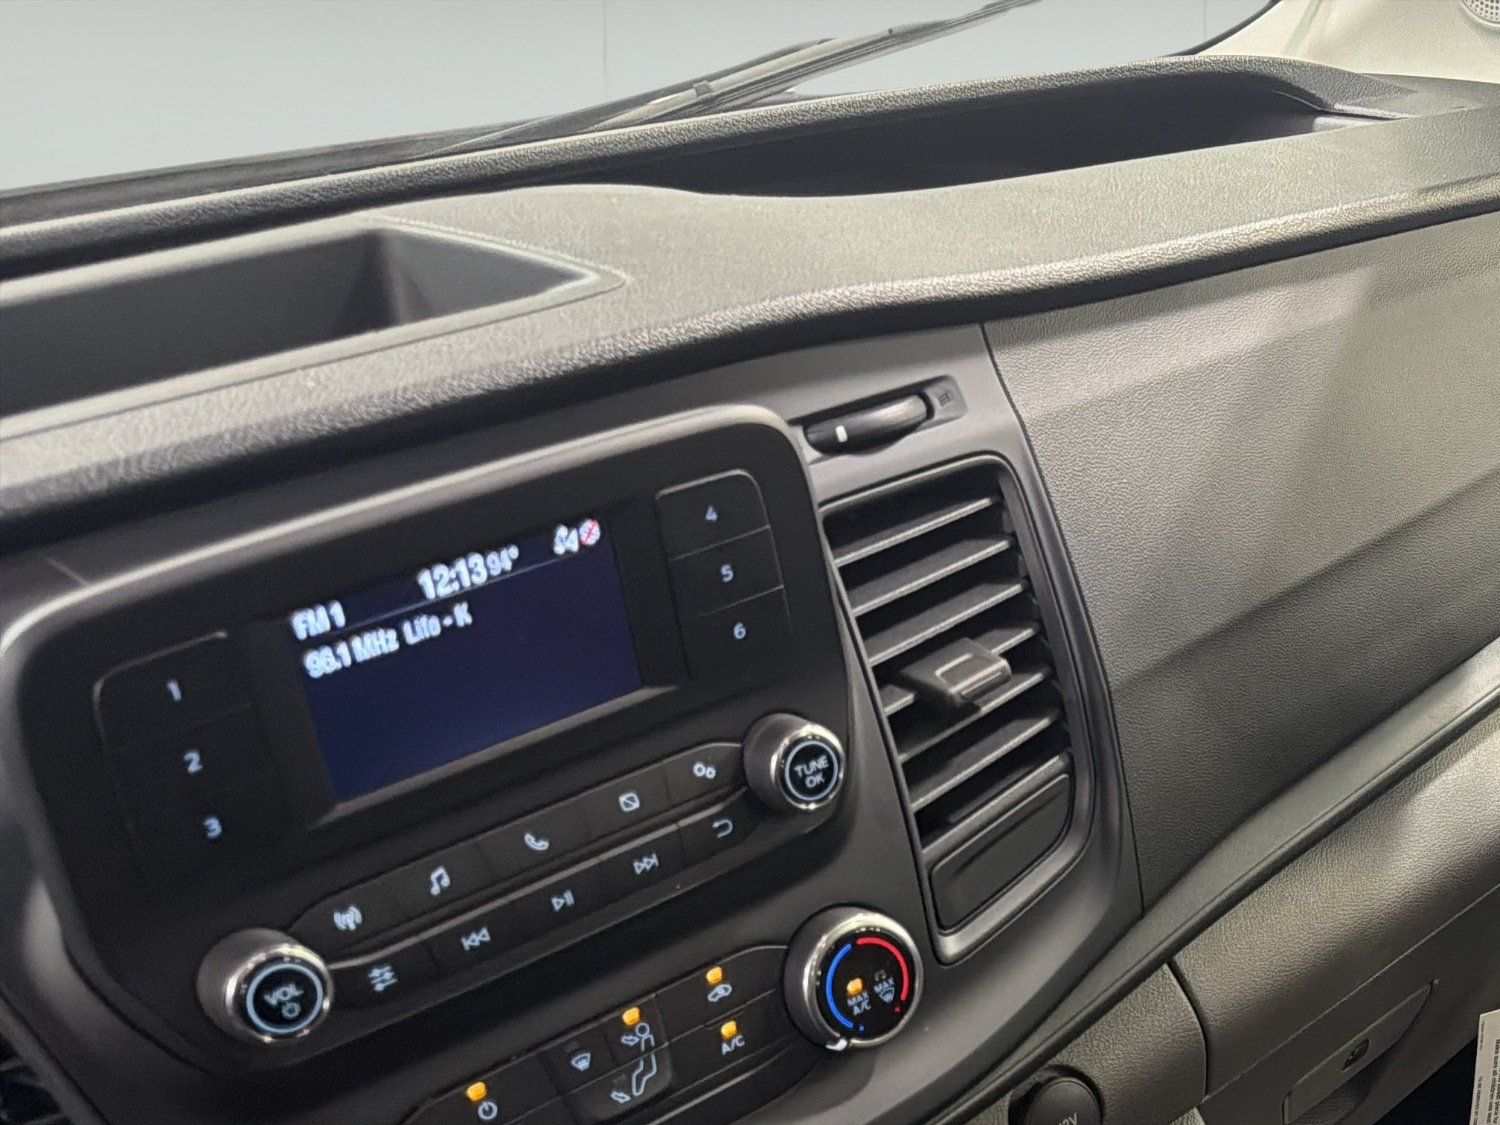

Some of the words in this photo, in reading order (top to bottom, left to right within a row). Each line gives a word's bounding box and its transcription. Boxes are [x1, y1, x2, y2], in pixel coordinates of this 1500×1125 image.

[705, 506, 718, 522] 4
[416, 552, 487, 601] 12:13
[720, 563, 734, 583] 5
[291, 604, 330, 640] FM
[329, 601, 345, 629] 1
[733, 622, 747, 640] 6
[352, 627, 399, 663] MHz
[453, 602, 473, 628] K
[166, 679, 182, 701] 1
[184, 751, 203, 774] 2
[794, 755, 829, 779] TUNE
[805, 772, 825, 788] OK
[203, 816, 222, 839] 3
[264, 984, 304, 1006] VOL
[873, 977, 894, 995] MAX
[847, 991, 869, 1007] MAX
[853, 1000, 871, 1016] A/C
[721, 1035, 745, 1055] A/C
